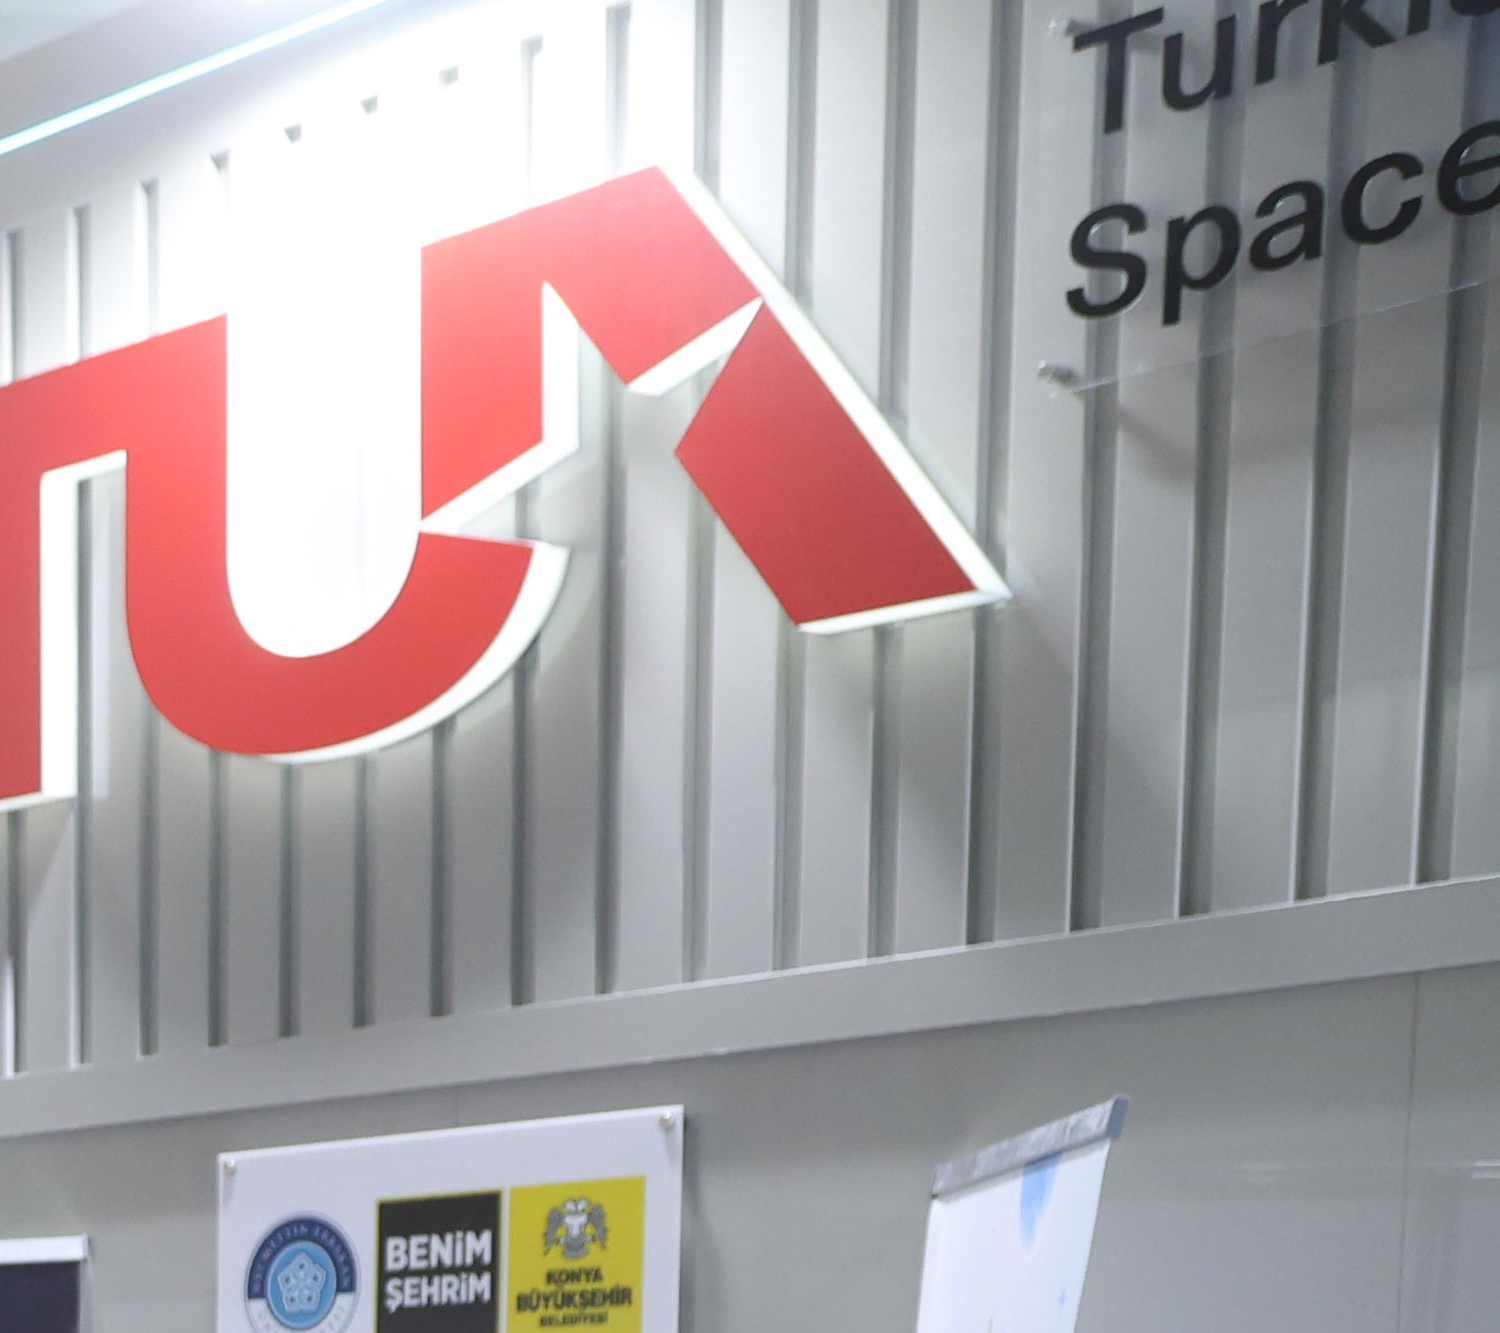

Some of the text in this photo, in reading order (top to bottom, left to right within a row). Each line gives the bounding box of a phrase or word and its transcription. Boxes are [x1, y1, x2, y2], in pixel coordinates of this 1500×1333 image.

[1066, 120, 1500, 327] Space
[385, 1229, 492, 1271] BENİM
[384, 1271, 491, 1314] ŞEHRİM
[546, 1266, 603, 1285] KONYA
[516, 1285, 633, 1312] BÜYÜKŞEHİR
